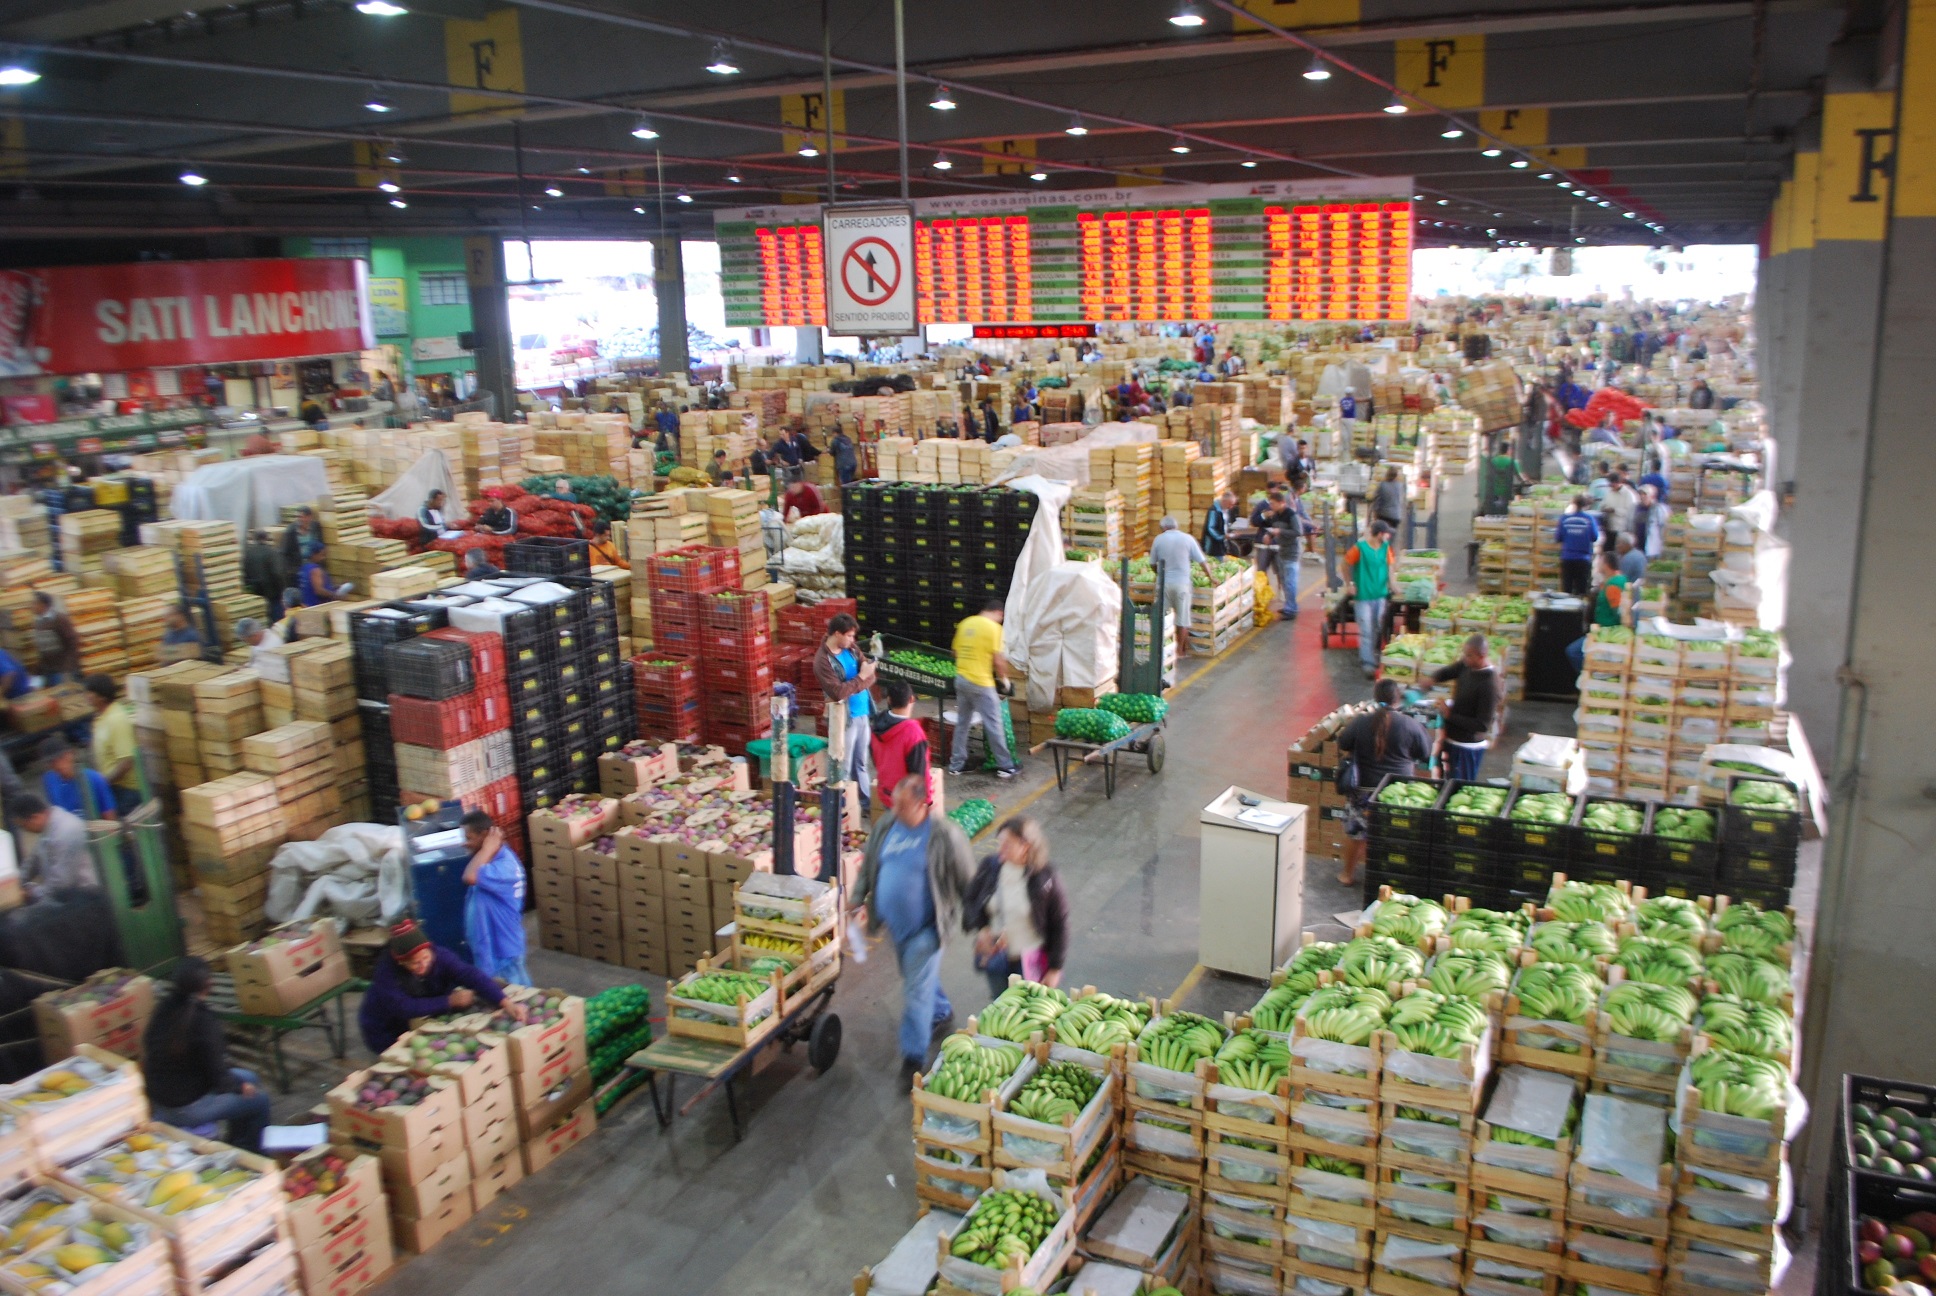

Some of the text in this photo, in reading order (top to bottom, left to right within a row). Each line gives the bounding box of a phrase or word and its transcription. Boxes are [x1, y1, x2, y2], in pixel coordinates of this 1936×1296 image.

[469, 38, 497, 91] F
[1423, 39, 1456, 88] F
[800, 92, 824, 132] F
[1849, 127, 1898, 204] F
[929, 191, 1133, 208] www.ceasaminas.com.br
[832, 216, 908, 230] CARREGADORES
[97, 297, 194, 344] SATI
[834, 311, 910, 322] SENTIDO PROIBIDO
